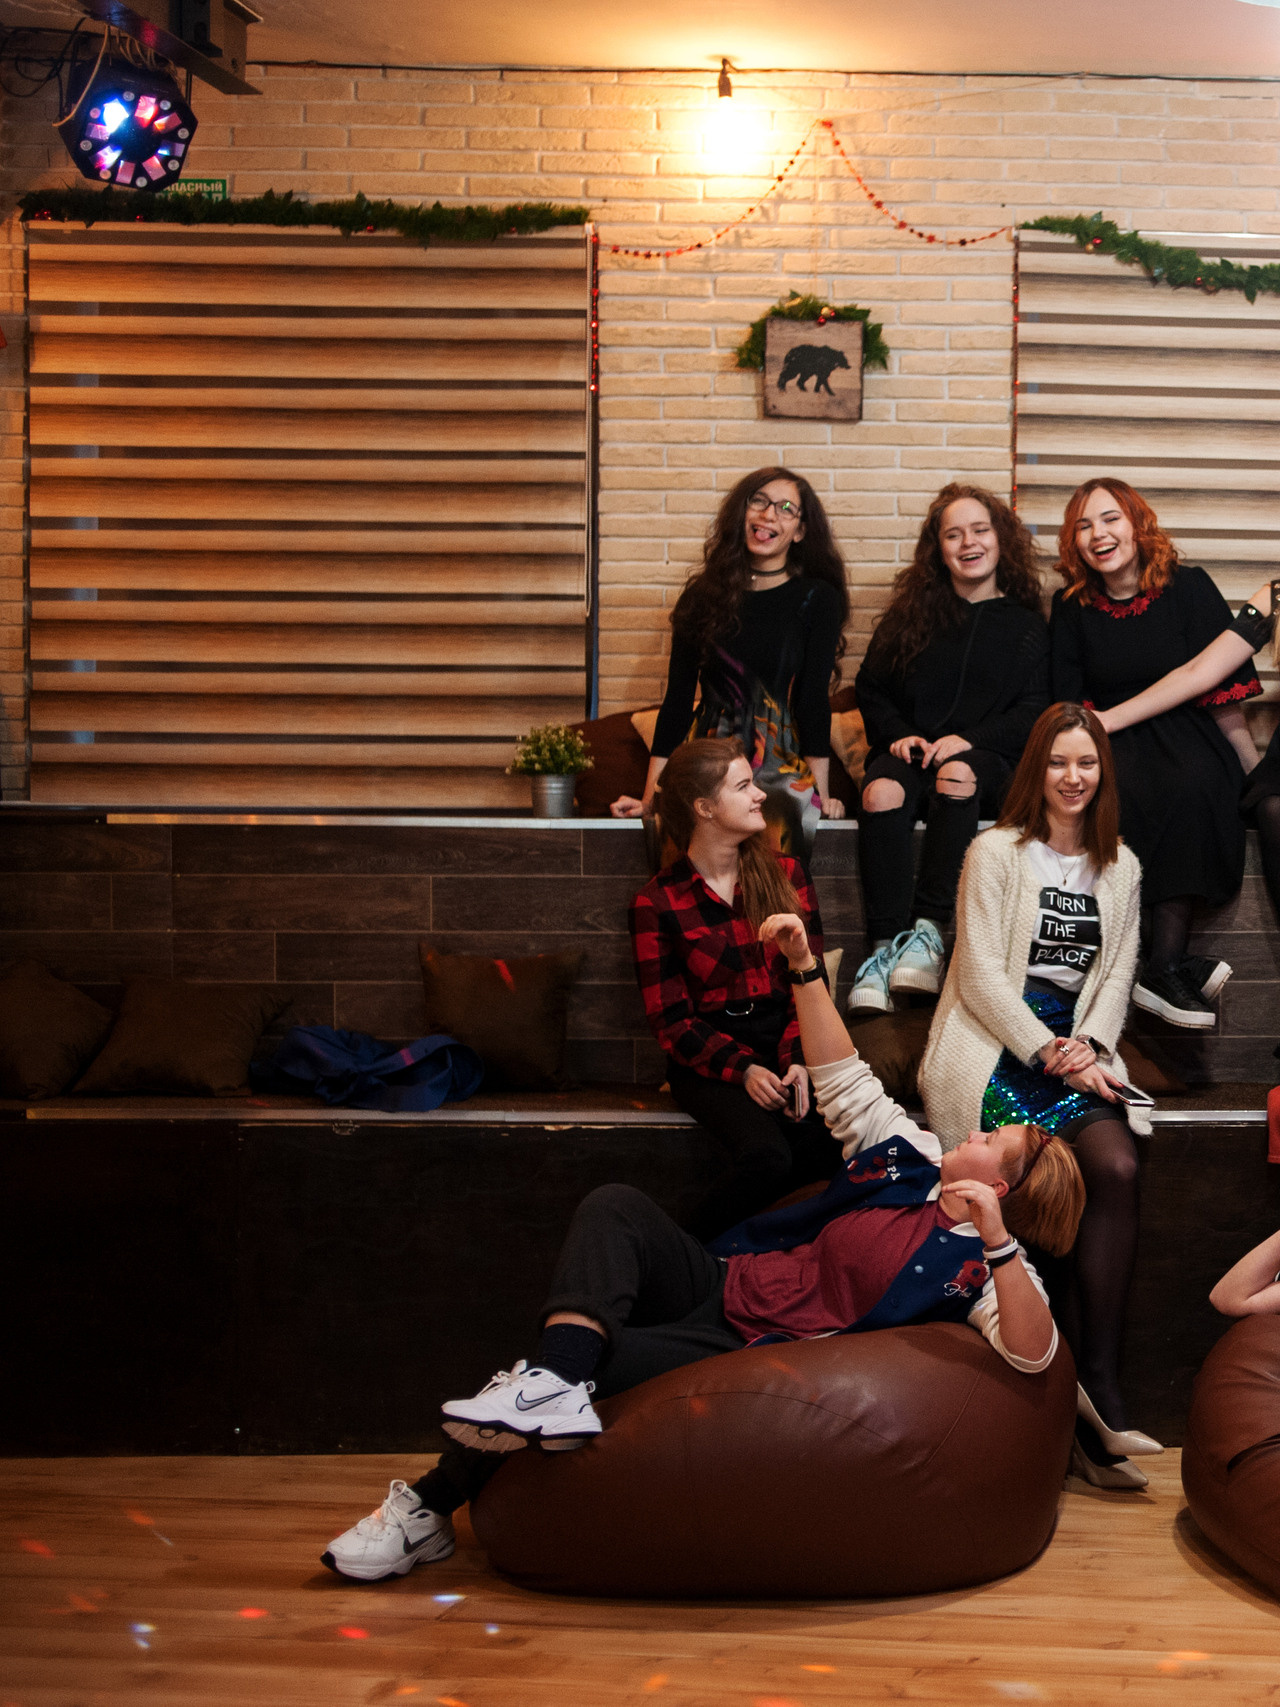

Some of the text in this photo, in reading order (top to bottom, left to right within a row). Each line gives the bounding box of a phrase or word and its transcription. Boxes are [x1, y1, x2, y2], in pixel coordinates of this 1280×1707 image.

[163, 181, 222, 192] АПАСНЫЙ
[1046, 891, 1086, 912] TURN
[1044, 919, 1076, 938] THE
[1034, 948, 1091, 967] PLACE
